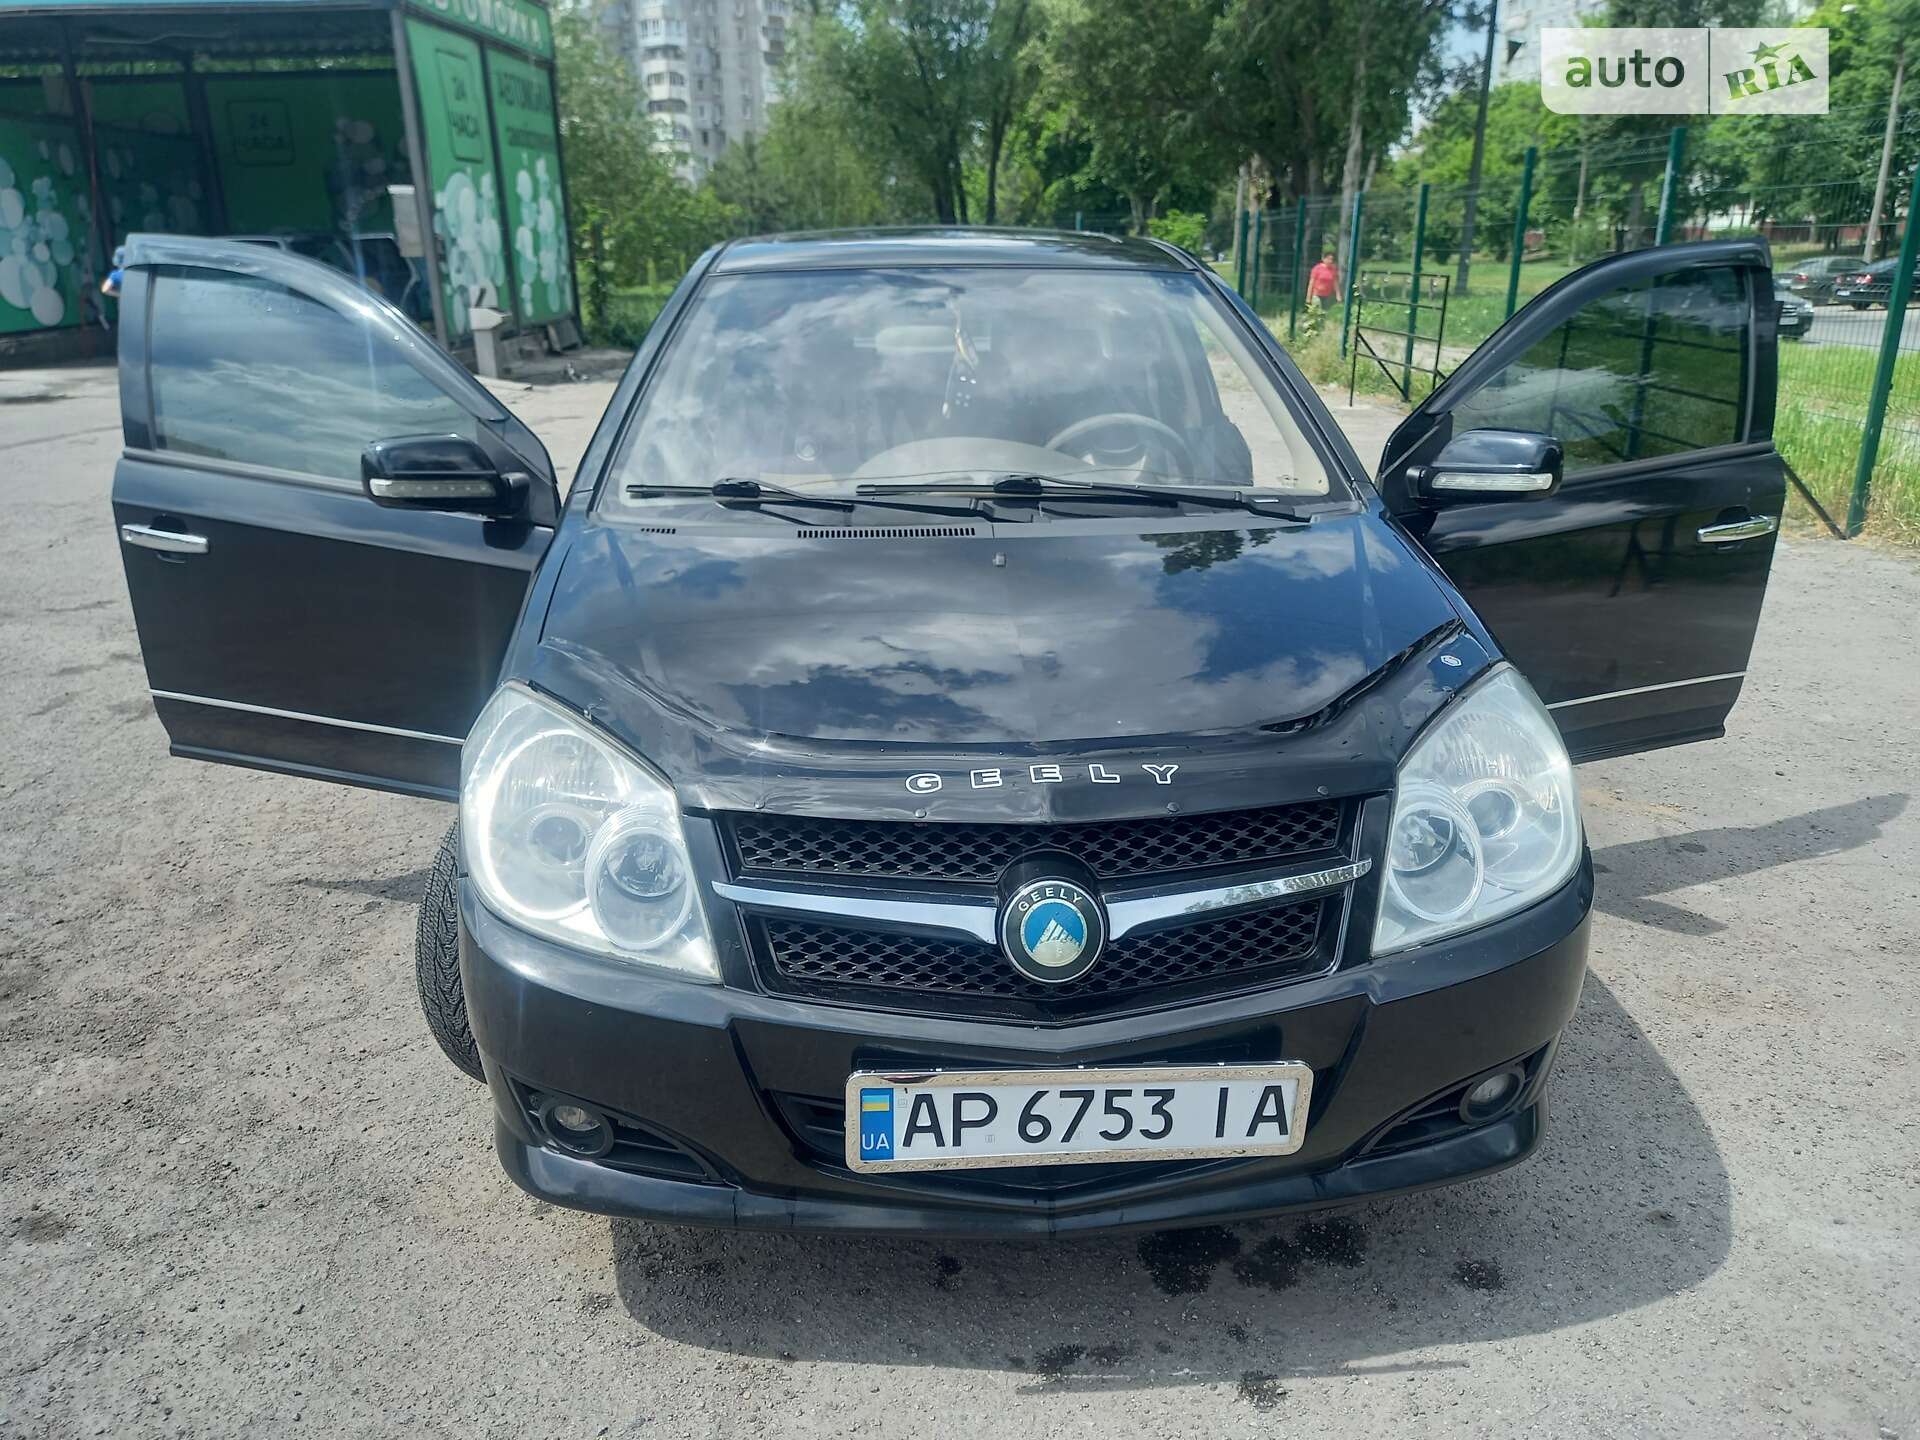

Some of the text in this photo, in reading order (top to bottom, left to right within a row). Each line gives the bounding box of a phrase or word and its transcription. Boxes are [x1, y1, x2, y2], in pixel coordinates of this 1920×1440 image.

[426, 0, 541, 45] ОМОЙКА
[906, 764, 1179, 794] GEELY
[1018, 887, 1082, 912] GEELY
[902, 1085, 1289, 1147] AP 6753 IA
[862, 1134, 890, 1150] UA
